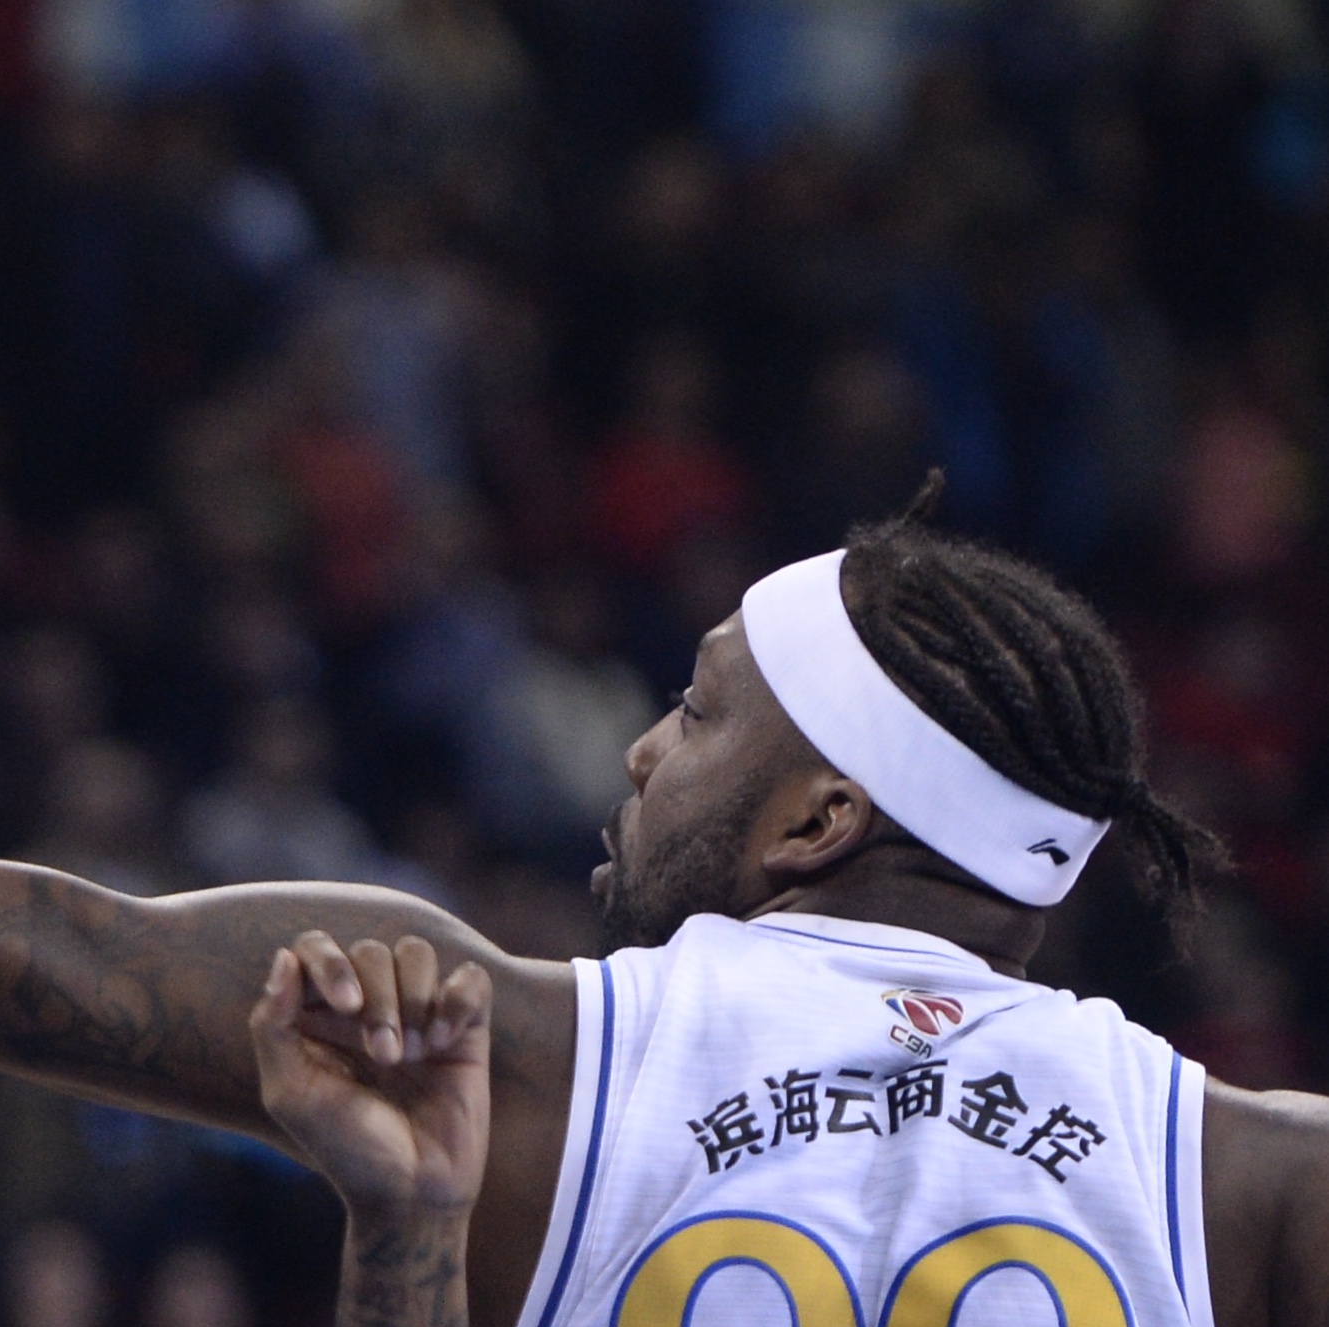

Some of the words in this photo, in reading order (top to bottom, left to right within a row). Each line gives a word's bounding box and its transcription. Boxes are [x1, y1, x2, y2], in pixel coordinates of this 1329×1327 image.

[686, 1058, 1108, 1185] 滨海云商金控
